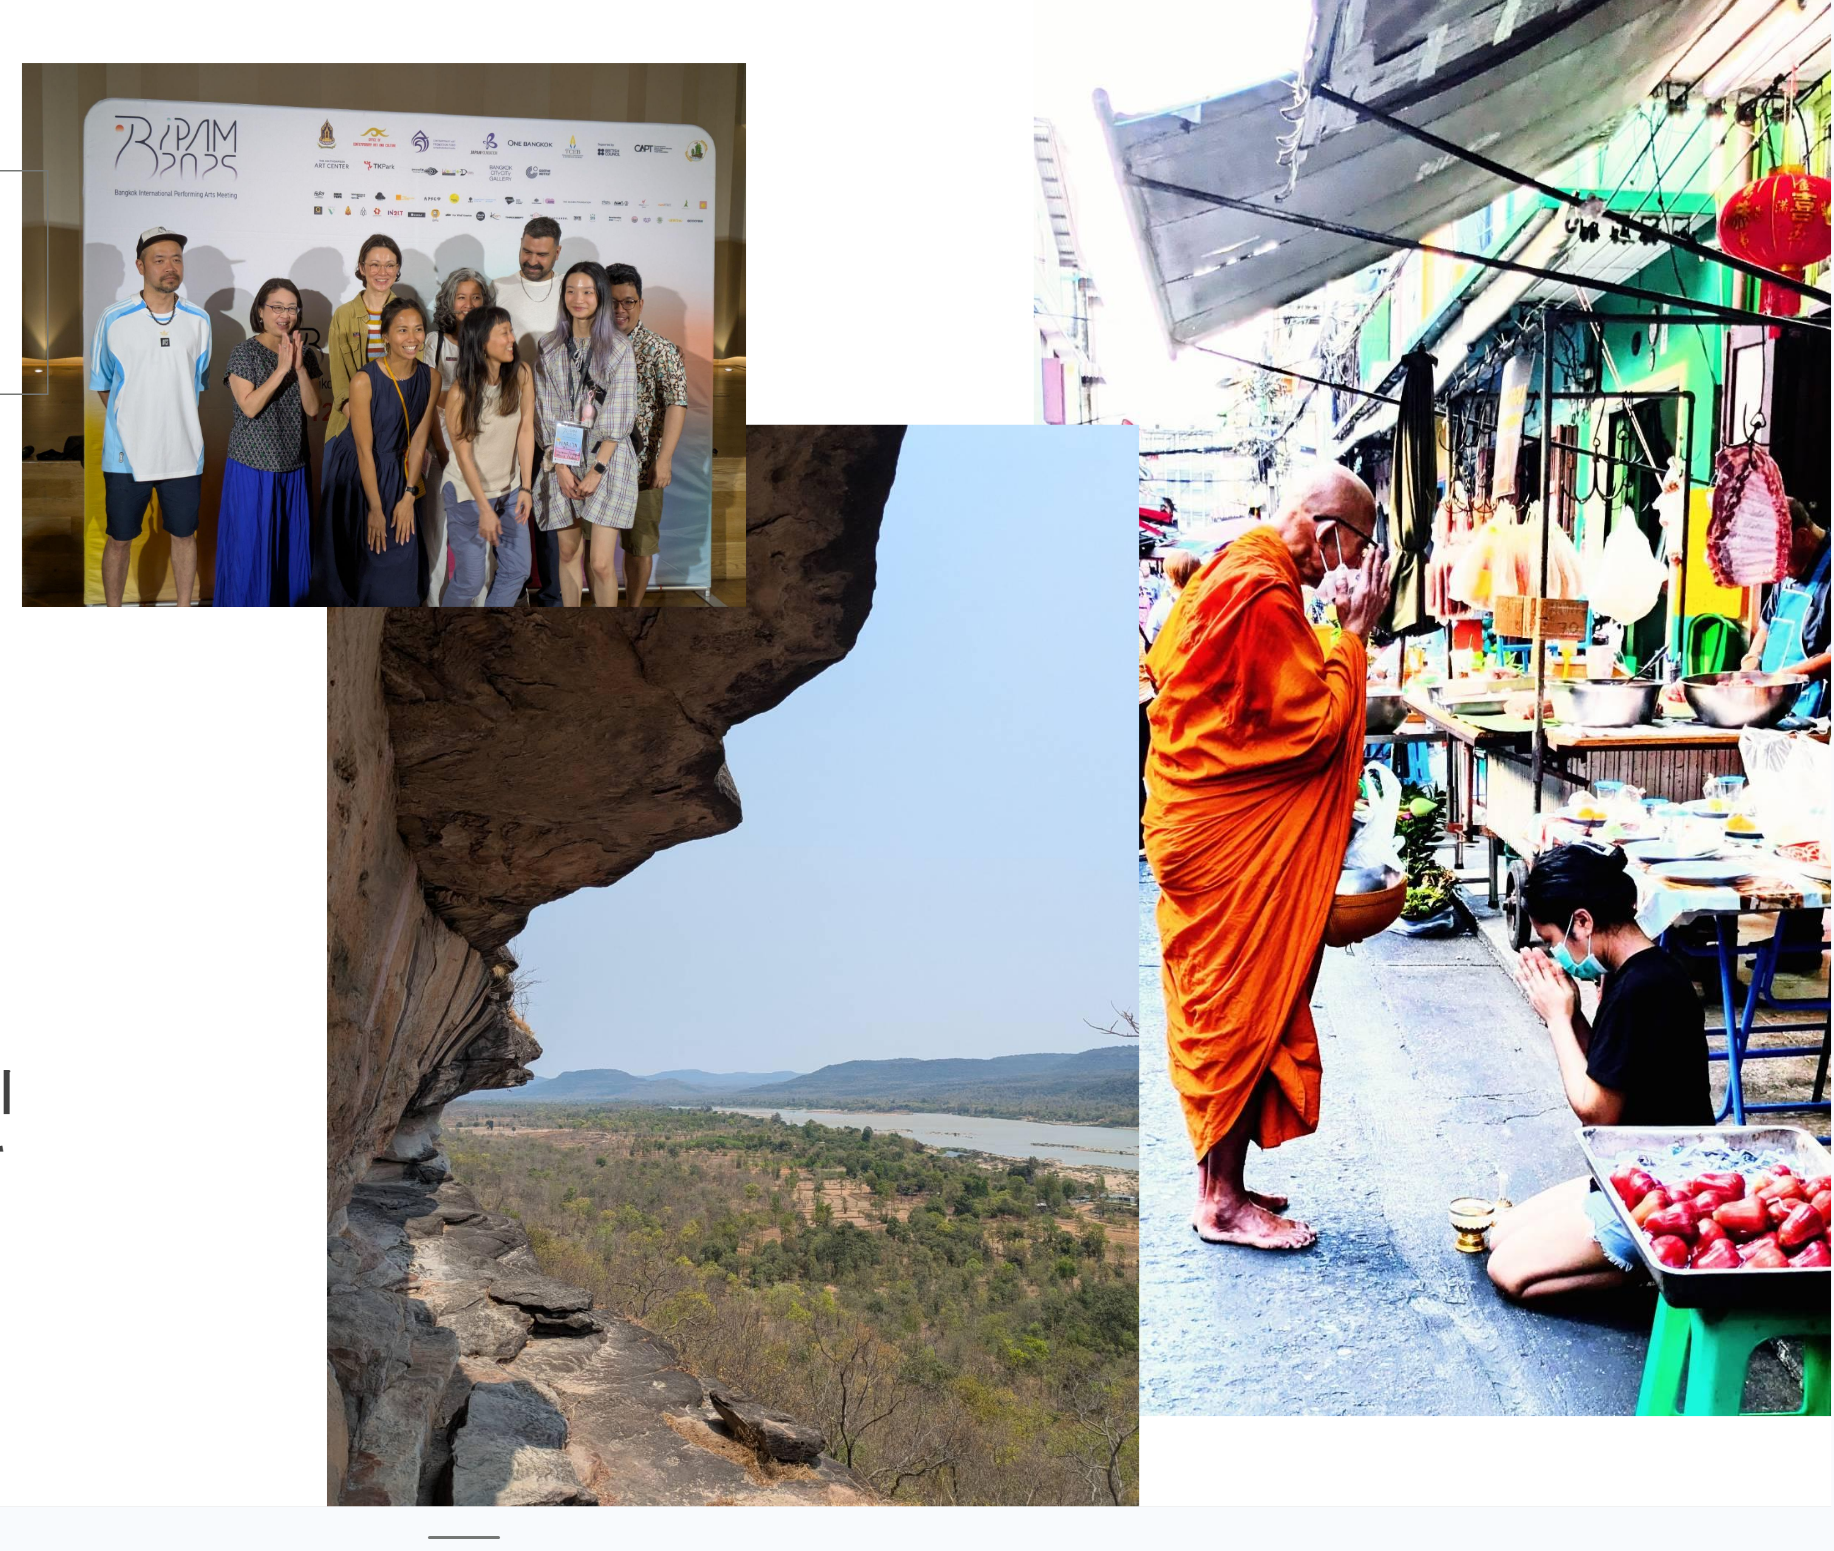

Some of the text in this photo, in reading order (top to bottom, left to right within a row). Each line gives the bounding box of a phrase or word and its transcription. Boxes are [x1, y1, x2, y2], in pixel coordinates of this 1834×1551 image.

[634, 144, 654, 153] CAPT
[114, 189, 137, 197] Bangkok
[139, 189, 173, 197] International
[174, 190, 203, 198] Performing
[217, 192, 238, 200] Meeting
